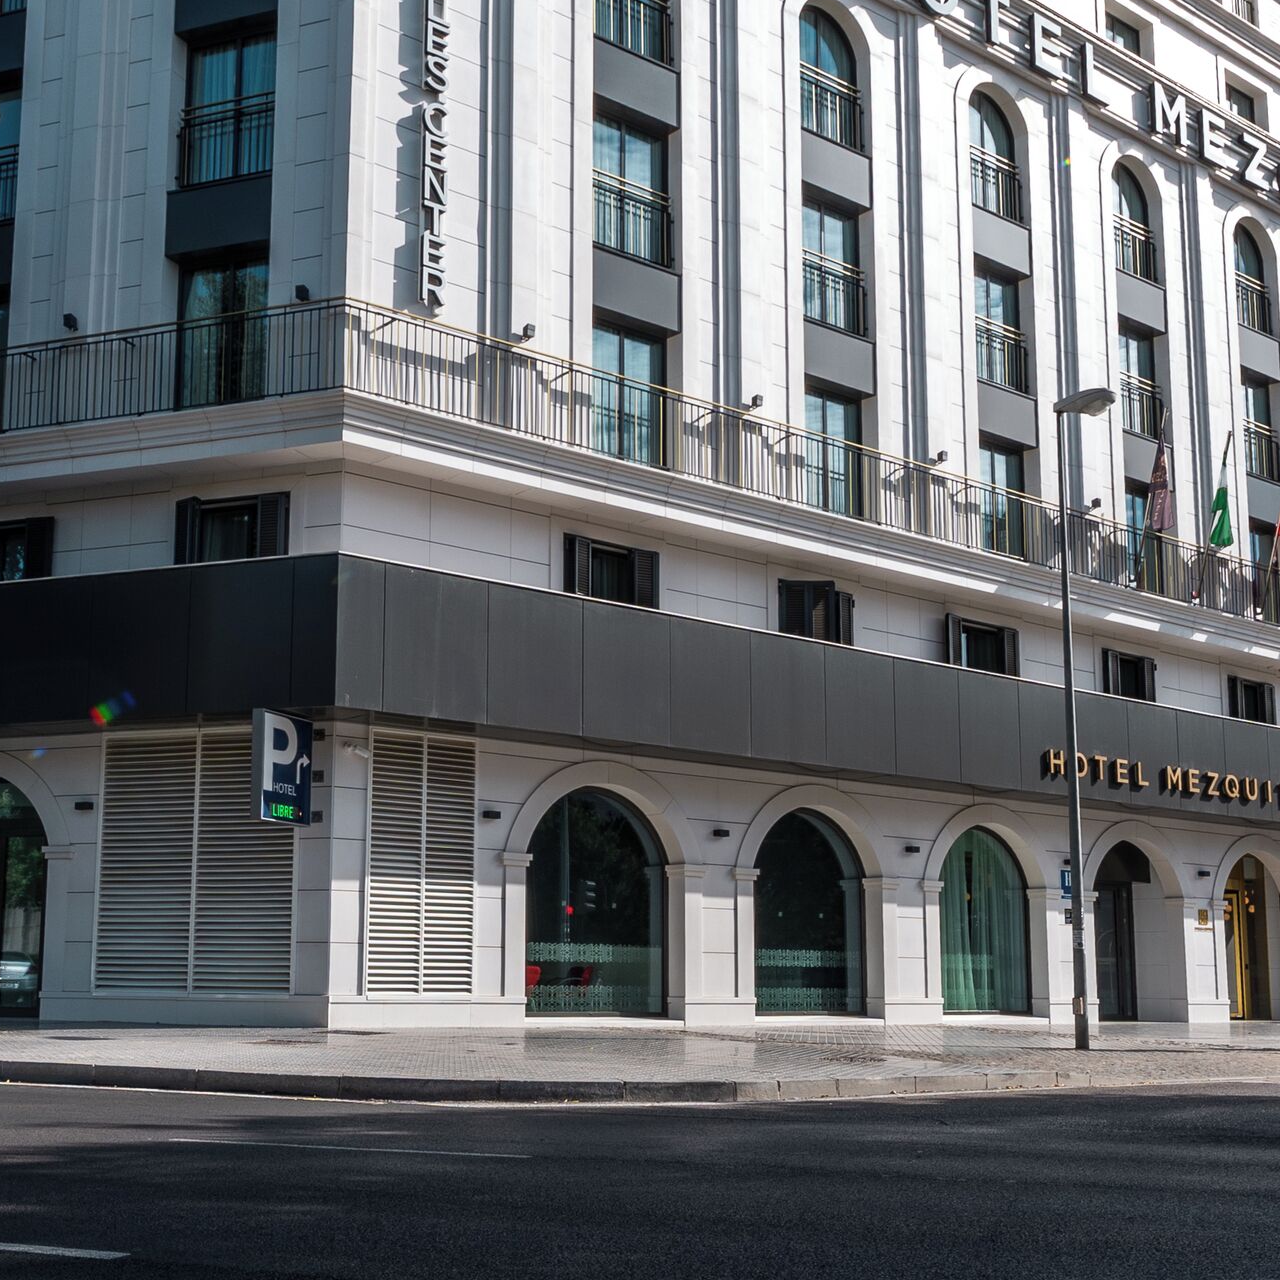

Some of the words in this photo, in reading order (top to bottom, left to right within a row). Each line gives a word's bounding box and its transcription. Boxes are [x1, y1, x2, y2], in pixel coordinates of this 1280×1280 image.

[423, 102, 448, 307] CENTER
[263, 712, 298, 791] P
[1049, 749, 1149, 787] HOTEL
[273, 783, 297, 797] HOTEL
[272, 803, 294, 819] LIBRE
